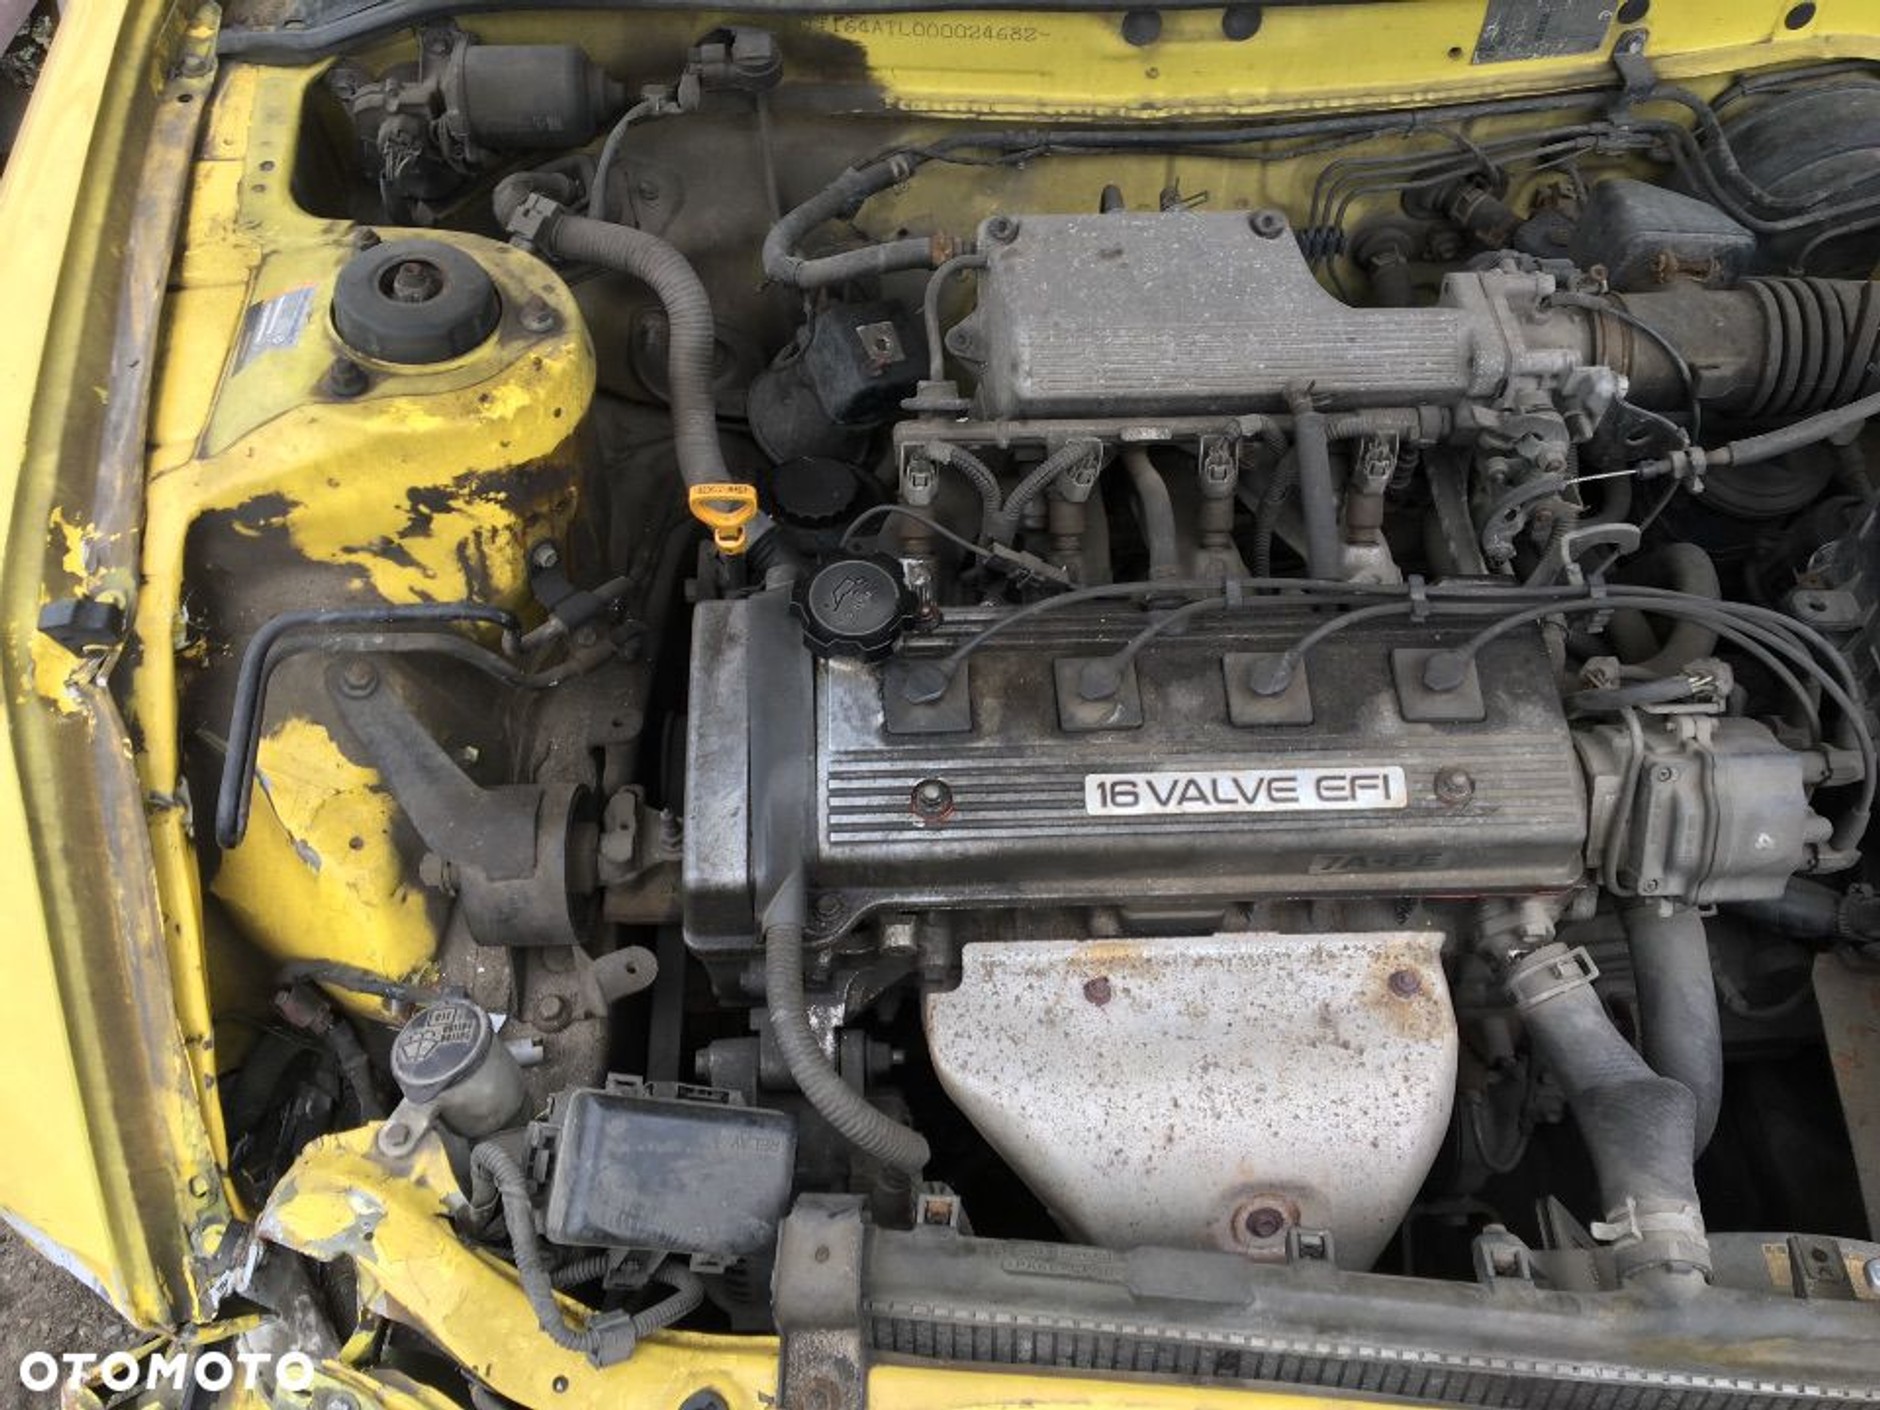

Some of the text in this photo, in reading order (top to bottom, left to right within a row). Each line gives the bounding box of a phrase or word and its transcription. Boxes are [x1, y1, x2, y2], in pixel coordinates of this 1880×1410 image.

[1096, 773, 1392, 808] 16 VALVE EFI
